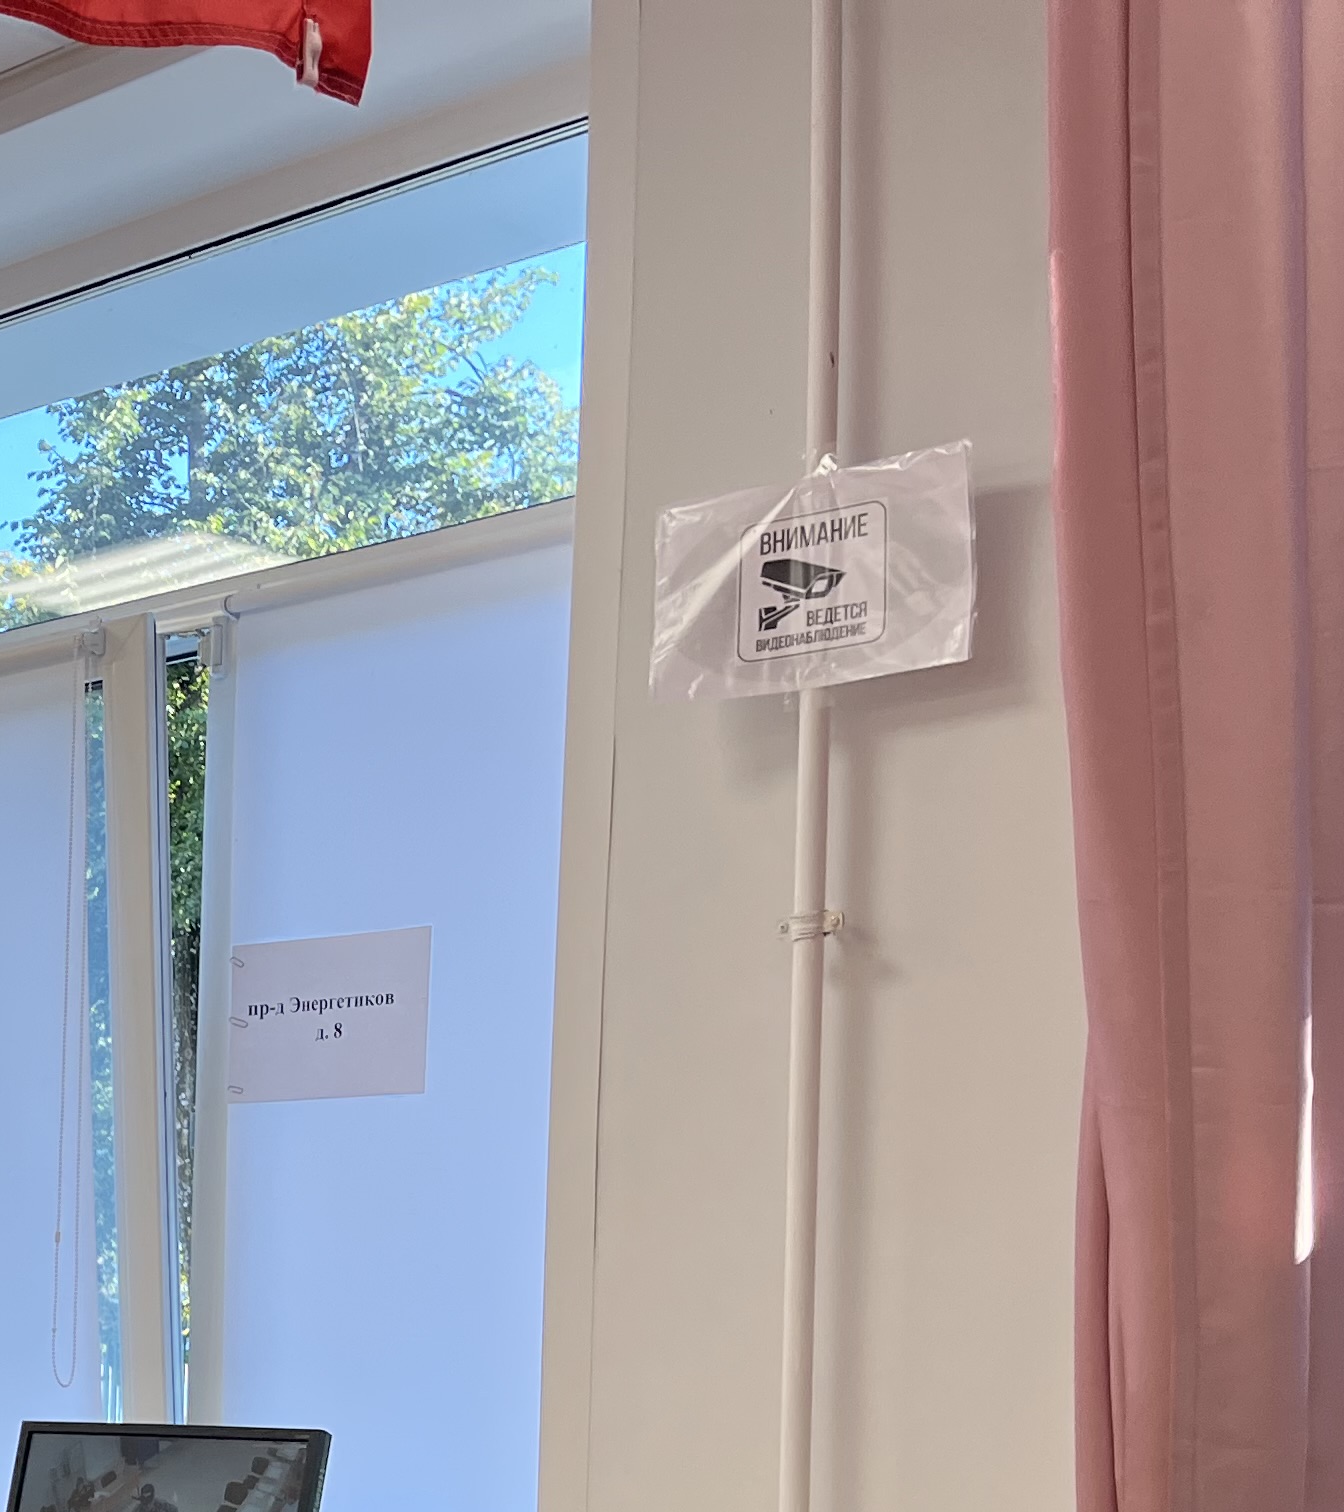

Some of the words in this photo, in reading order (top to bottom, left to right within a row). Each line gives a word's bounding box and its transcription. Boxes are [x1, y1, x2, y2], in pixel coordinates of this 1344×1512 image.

[760, 512, 869, 556] ВНИМАНИЕ
[806, 601, 868, 627] ВЕДЕТСЯ
[755, 621, 868, 653] ВИДЕОНАБЛЮДЕНИЕ
[248, 1002, 285, 1020] пр-д
[289, 992, 395, 1016] Энергетиков
[315, 1028, 329, 1042] д.
[333, 1022, 343, 1039] 8
